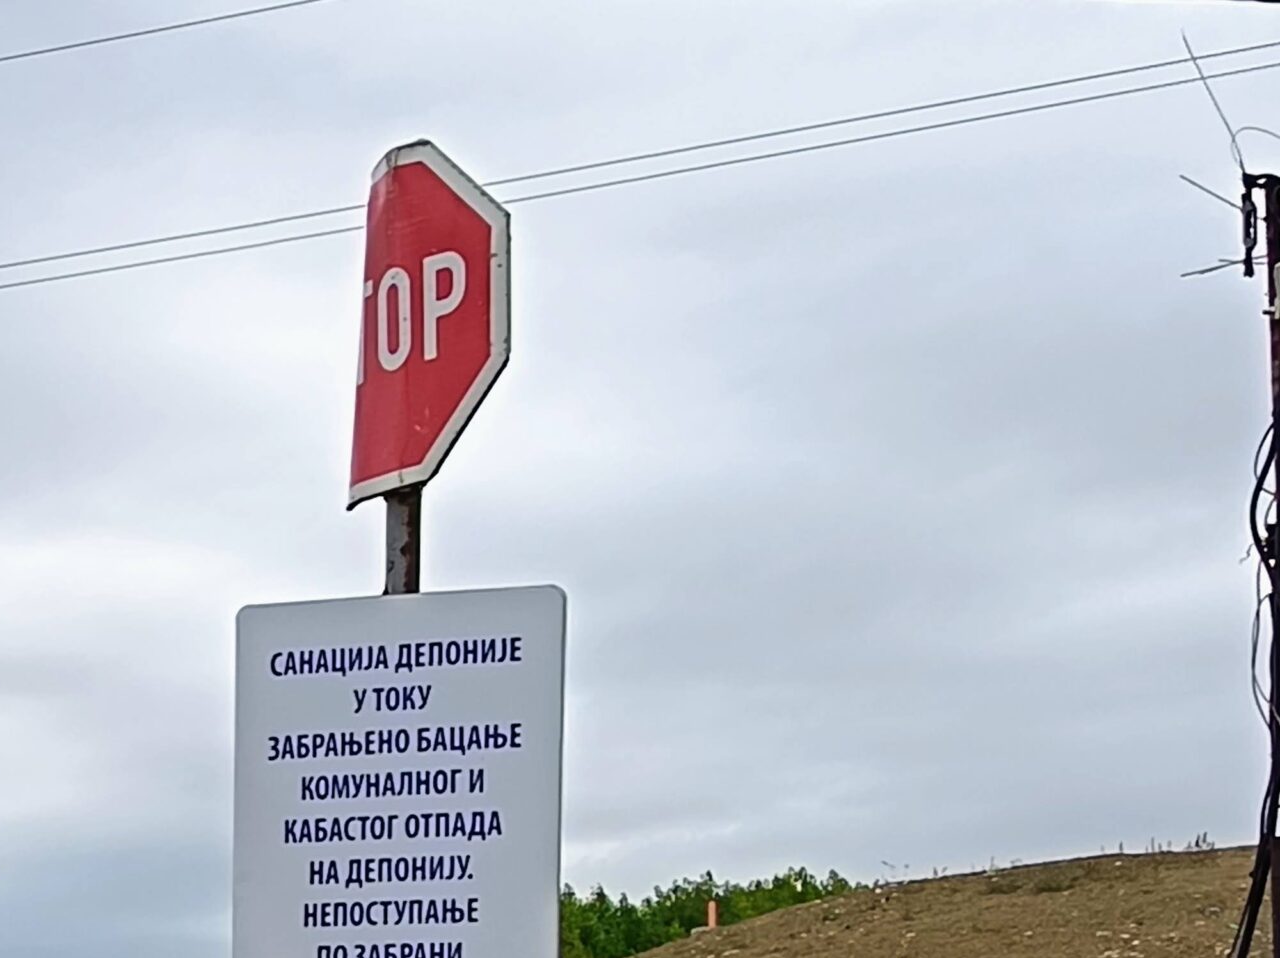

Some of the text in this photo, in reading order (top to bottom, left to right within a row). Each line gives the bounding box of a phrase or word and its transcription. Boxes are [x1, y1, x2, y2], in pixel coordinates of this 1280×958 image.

[270, 637, 523, 677] САНАЦИЈА ДЕПОНИЈЕ
[353, 685, 433, 714] У ТОКУ
[268, 723, 523, 761] ЗАБРАЊЕНО БАЦАЊЕ
[301, 769, 485, 801] КОМУНАЛНОГ И
[285, 811, 503, 844] КАБАСТОГ ОТПАДА
[310, 855, 474, 889] НА ДЕПОНИЈУ.
[304, 898, 479, 928] НЕПОСТУПАЊЕ
